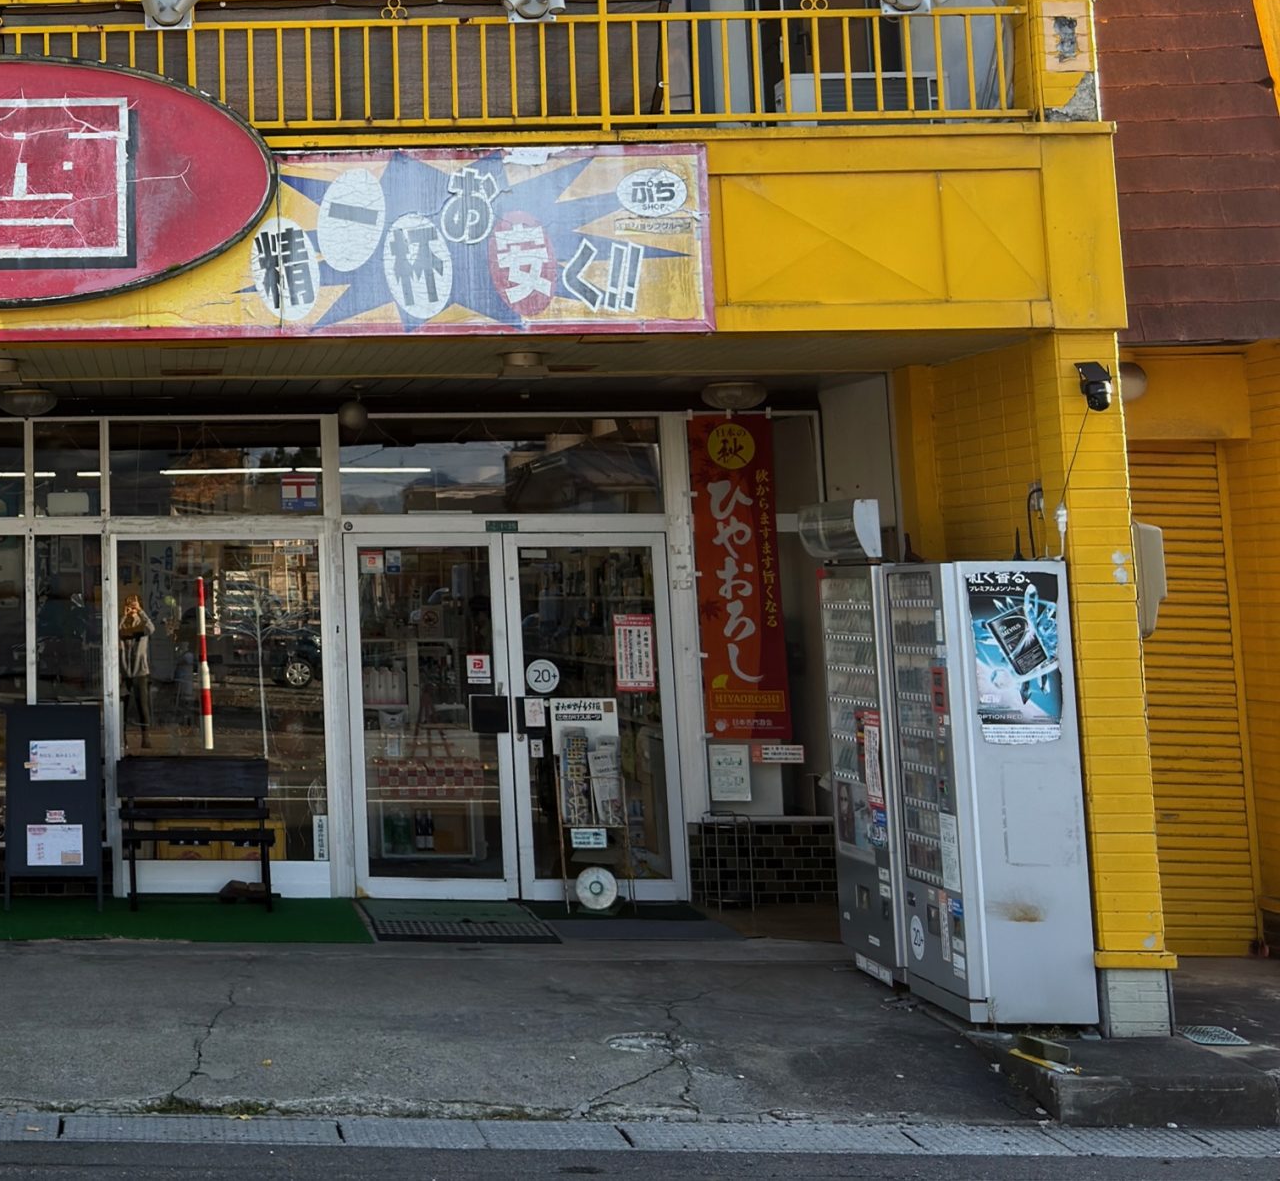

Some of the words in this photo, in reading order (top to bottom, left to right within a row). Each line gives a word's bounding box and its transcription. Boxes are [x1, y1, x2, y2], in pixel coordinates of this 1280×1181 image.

[631, 180, 676, 203] ぷち
[642, 203, 666, 211] SHOP
[716, 429, 746, 438] 日本の
[717, 438, 747, 464] 秋
[707, 480, 765, 683] ひやおろし
[533, 669, 558, 683] 20+
